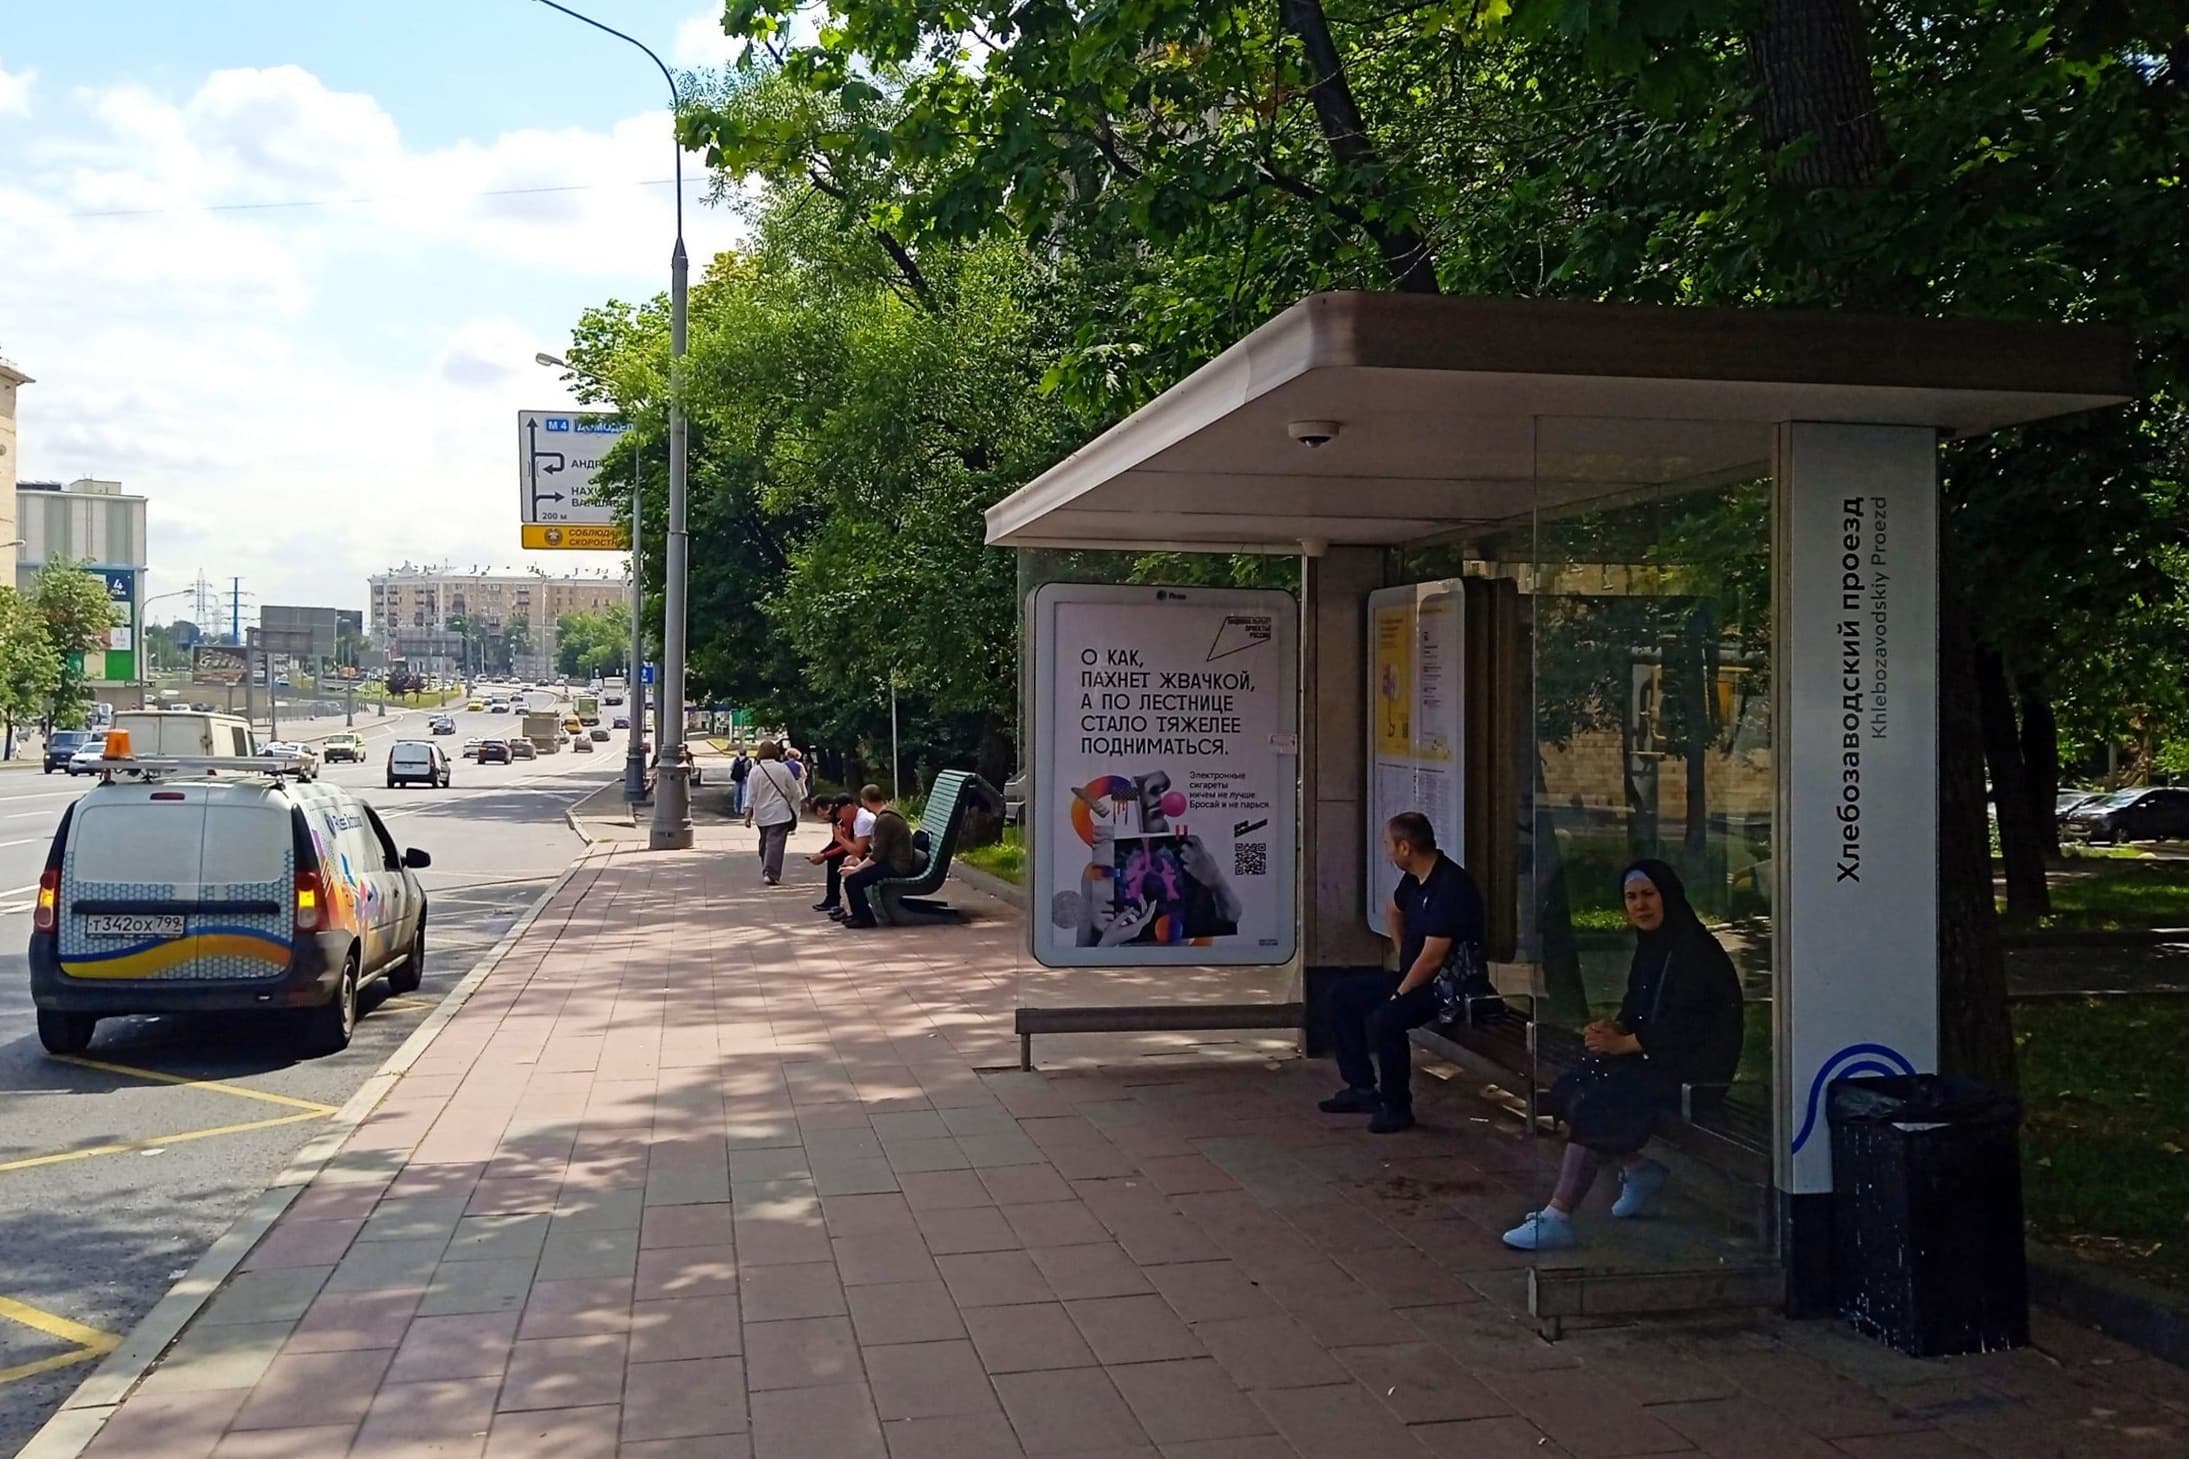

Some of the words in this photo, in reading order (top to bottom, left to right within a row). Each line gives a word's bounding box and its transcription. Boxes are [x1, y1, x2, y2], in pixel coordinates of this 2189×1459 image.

[571, 459, 604, 470] АНДР
[571, 487, 600, 495] НАХ
[542, 512, 558, 520] 200
[1870, 497, 1887, 565] Proezd
[569, 538, 619, 546] СКОРОСТН
[1842, 497, 1865, 609] проезд
[1081, 648, 1098, 666] О
[1108, 650, 1144, 668] КАК,
[1870, 572, 1890, 739] Khlebozavodskiy
[1081, 671, 1151, 688] ПАХНЕТ
[1160, 670, 1255, 692] ЖВАЧКОЙ,
[1081, 693, 1092, 710] А
[1102, 693, 1130, 710] ПО
[1139, 694, 1234, 714] ЛЕСТНИЦЕ
[1081, 715, 1147, 732] СТАЛО
[1156, 716, 1241, 733] ТЯЖЕЛЕЕ
[1081, 737, 1229, 757] ПОДНИМАТЬСЯ.
[1836, 621, 1863, 883] Хлебозаводский
[1189, 771, 1246, 780] Электронные
[1189, 782, 1228, 790] сигареты
[1229, 792, 1256, 800] лучше
[1189, 800, 1219, 810] Бросай
[93, 916, 153, 931] Т342ОХ
[156, 916, 180, 929] 799
